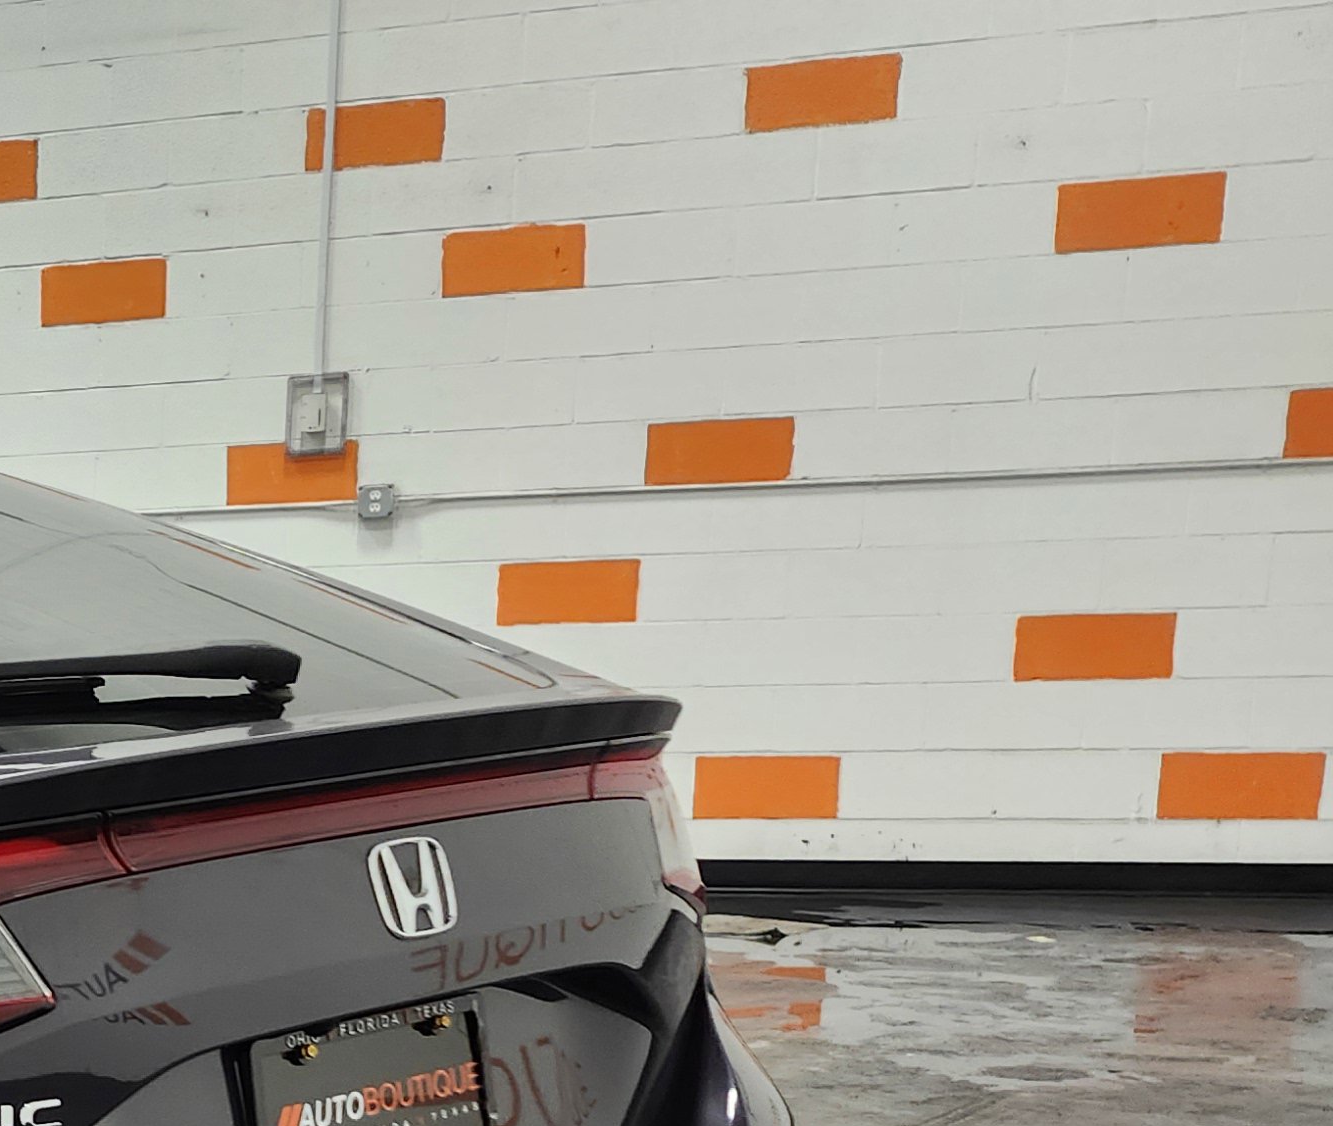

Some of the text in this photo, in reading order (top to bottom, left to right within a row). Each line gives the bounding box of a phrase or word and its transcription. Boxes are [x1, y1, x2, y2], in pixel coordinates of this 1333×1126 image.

[339, 1013, 401, 1038] FLORIDA
[414, 999, 455, 1020] TEXAS
[430, 1101, 480, 1121] TEXAS
